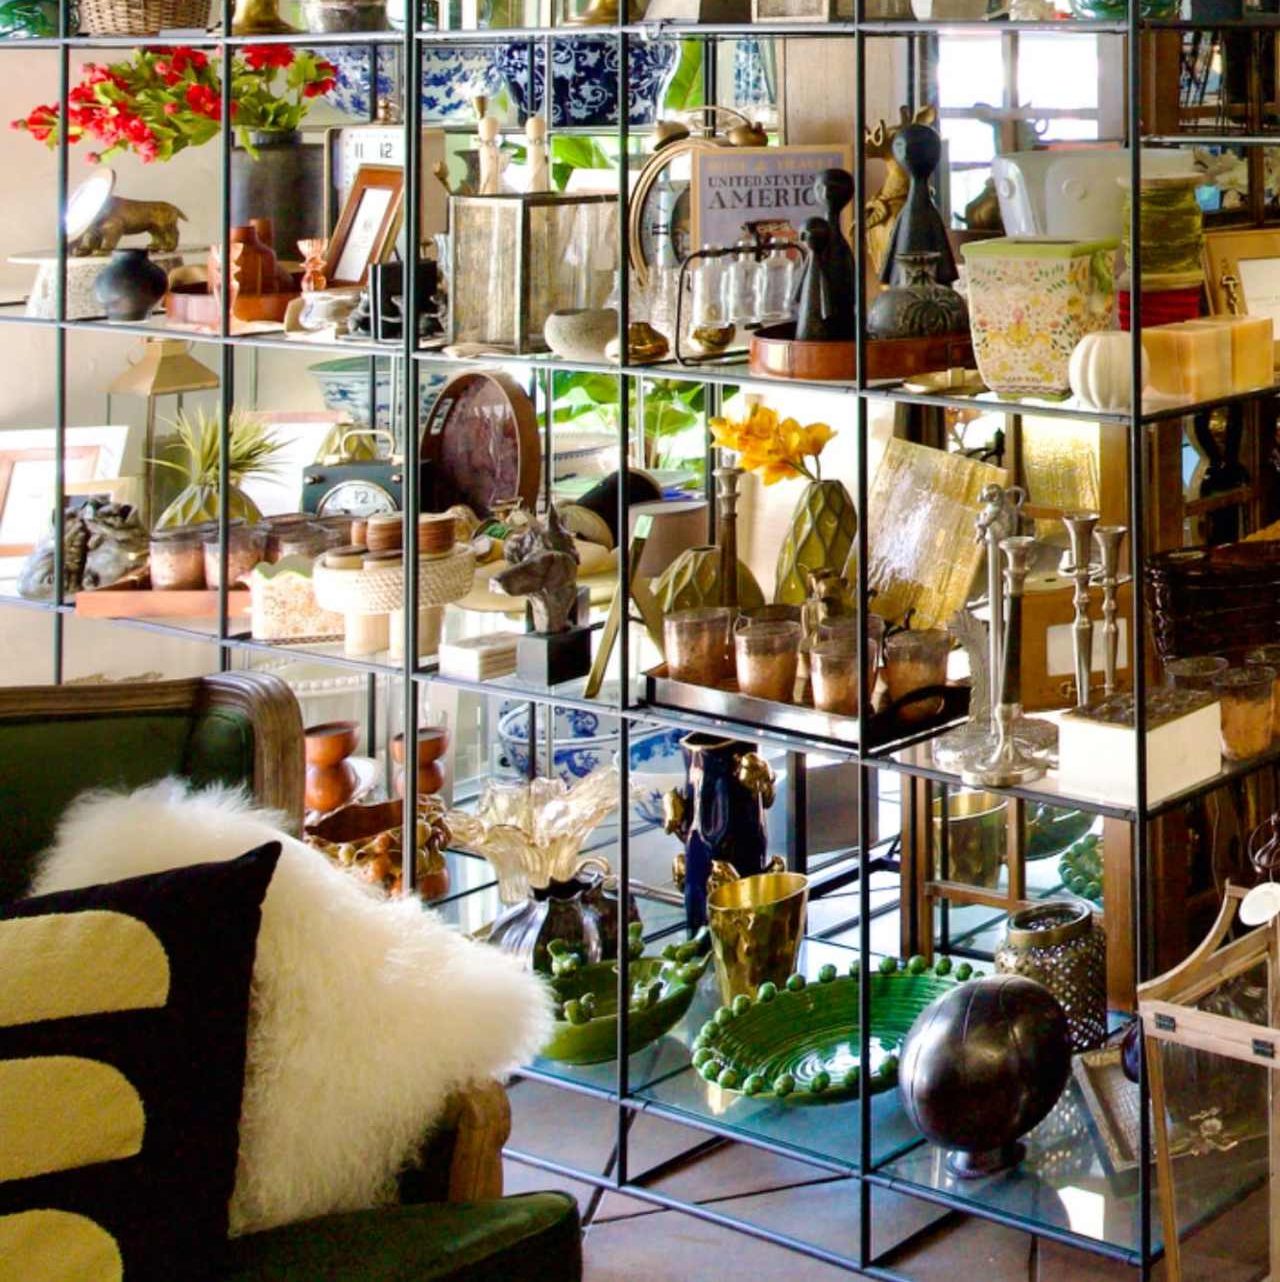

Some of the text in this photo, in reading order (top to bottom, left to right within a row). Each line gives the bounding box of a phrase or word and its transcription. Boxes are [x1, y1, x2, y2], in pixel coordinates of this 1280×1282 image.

[354, 142, 393, 159] 11 12
[708, 173, 816, 188] UNITED STATES
[707, 187, 818, 210] AMERIC
[354, 490, 369, 504] 12
